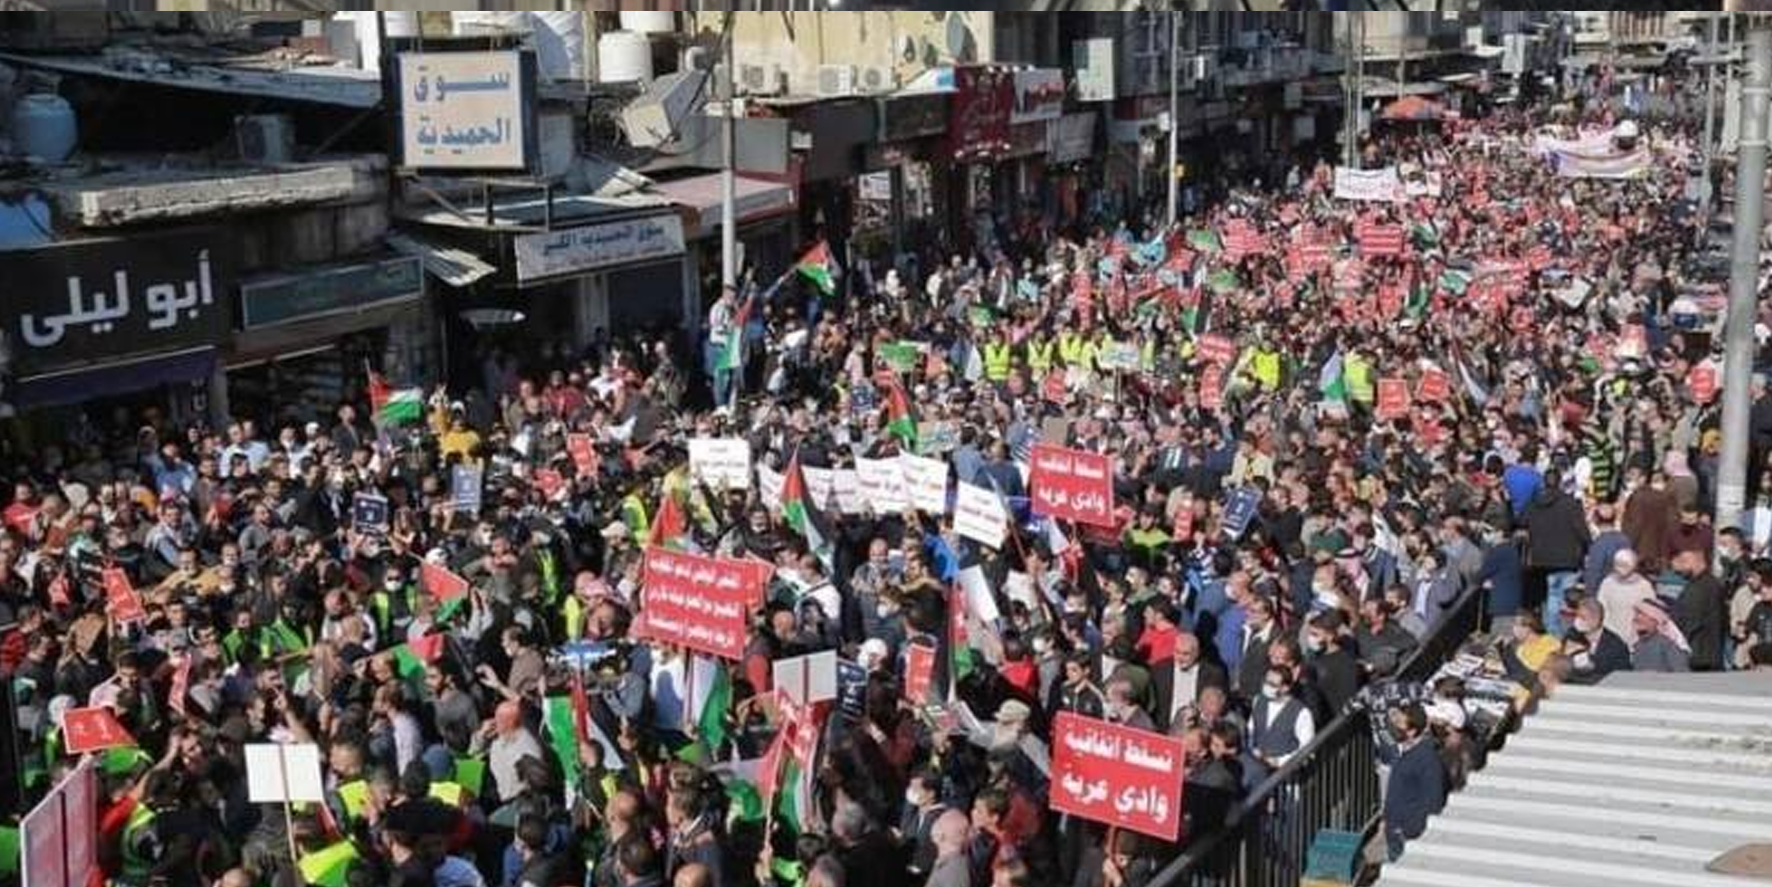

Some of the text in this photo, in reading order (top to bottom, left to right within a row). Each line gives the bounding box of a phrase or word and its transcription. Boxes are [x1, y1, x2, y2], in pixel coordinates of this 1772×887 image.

[414, 66, 510, 102] سوق
[417, 117, 511, 155] الحميدية
[21, 269, 130, 348] ليلى
[146, 248, 213, 330] أبو
[1062, 762, 1168, 824] وادي عربة
